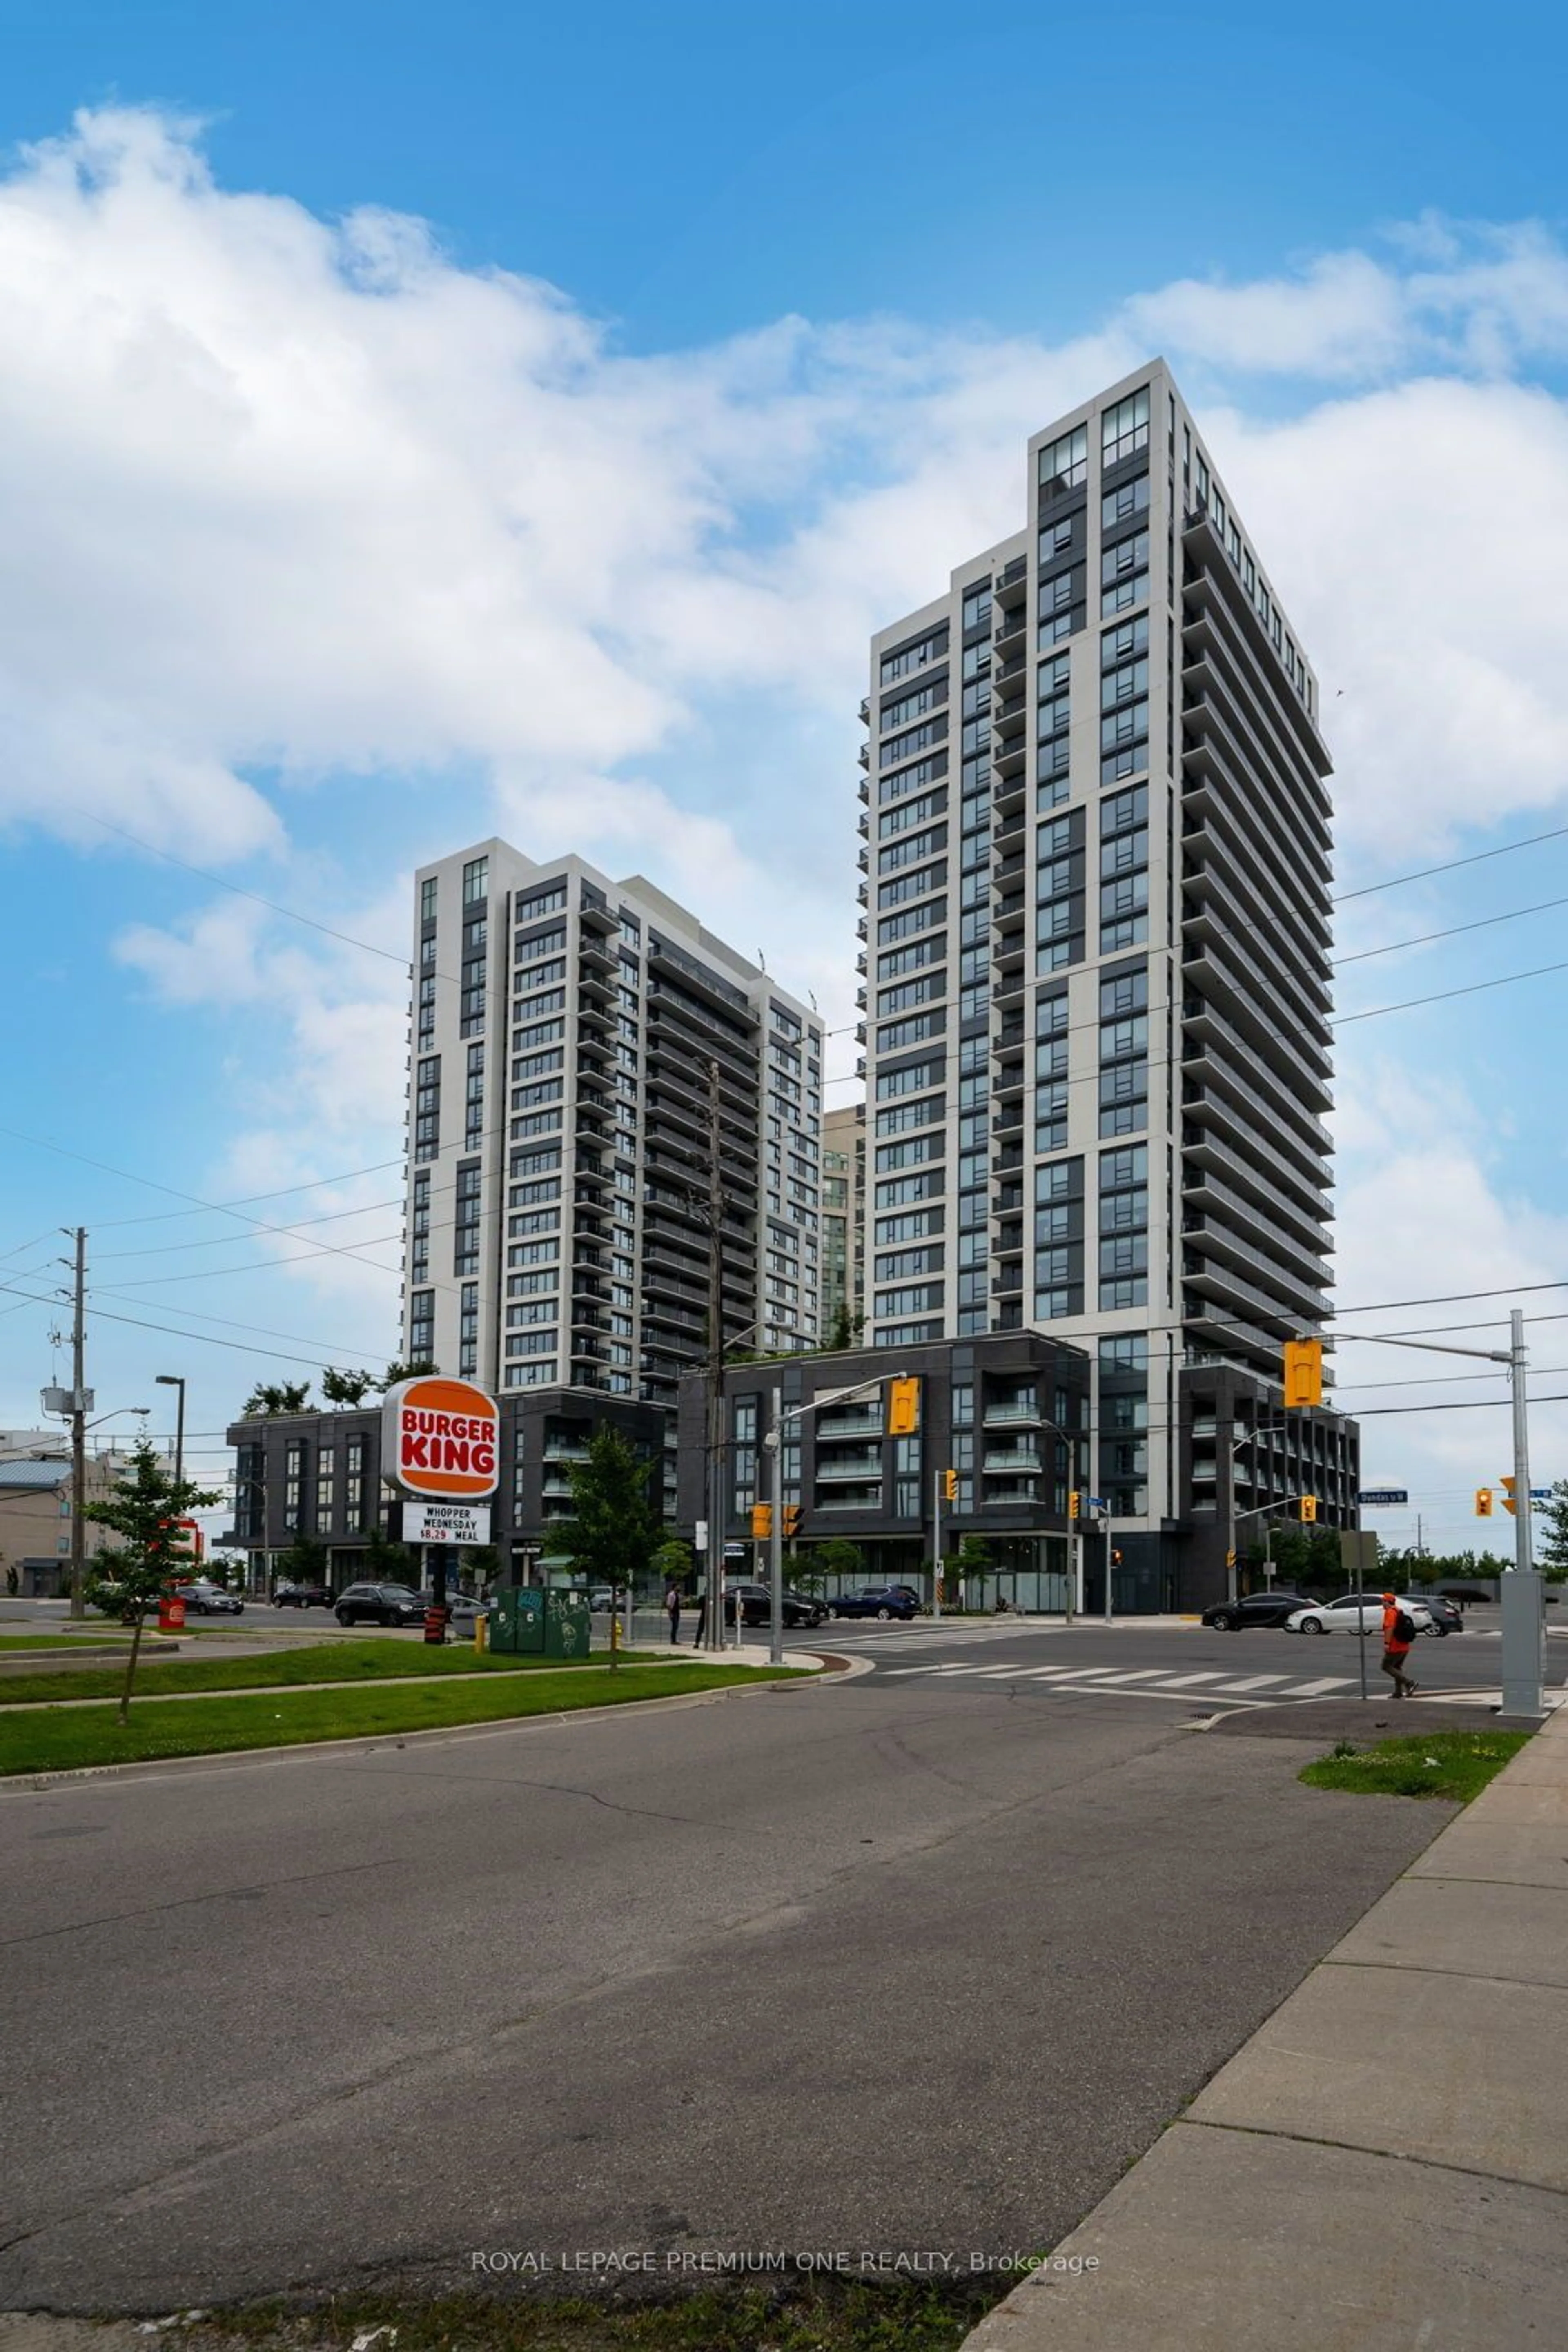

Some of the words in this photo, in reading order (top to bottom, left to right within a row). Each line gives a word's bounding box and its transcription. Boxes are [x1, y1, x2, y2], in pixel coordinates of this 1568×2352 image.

[402, 1410, 495, 1443] BURGER
[401, 1433, 494, 1474] KING
[427, 1506, 470, 1518] WHOPPER
[424, 1519, 477, 1530] WEDNESDAY
[421, 1529, 446, 1540] $8.29
[455, 1530, 478, 1541] MEAL
